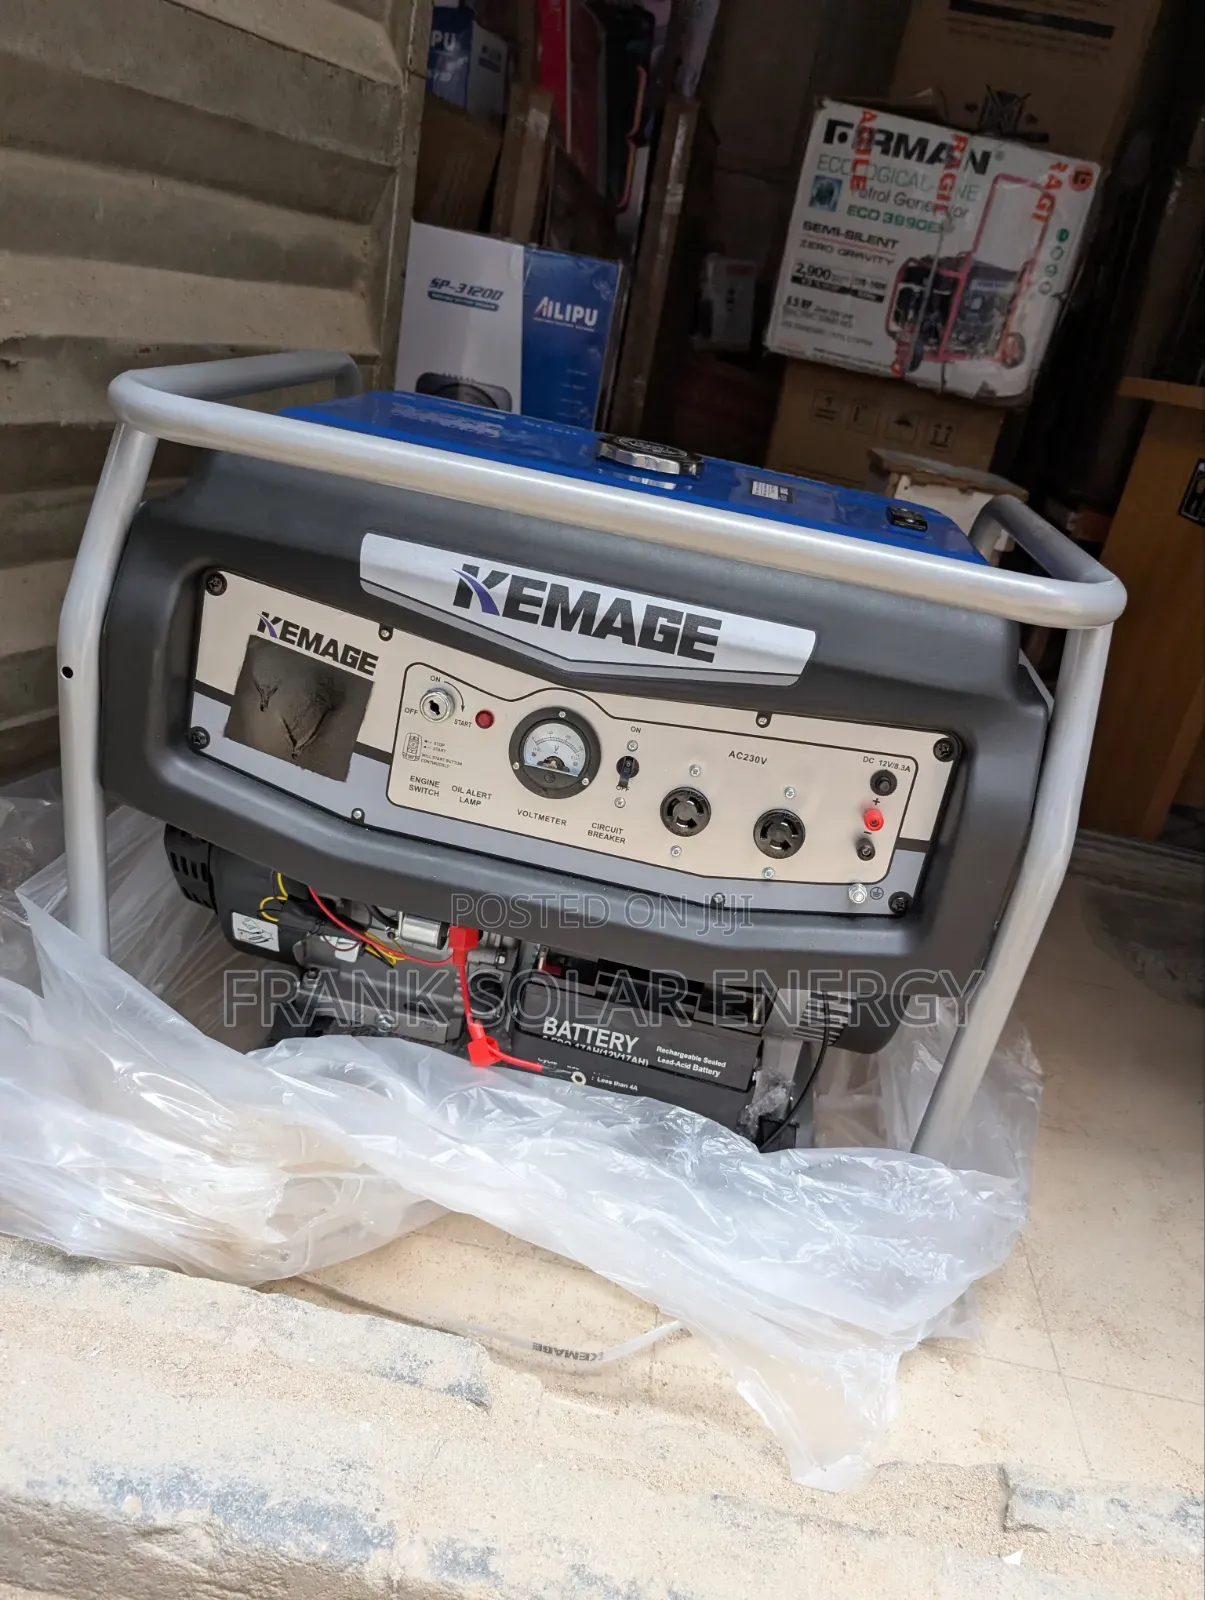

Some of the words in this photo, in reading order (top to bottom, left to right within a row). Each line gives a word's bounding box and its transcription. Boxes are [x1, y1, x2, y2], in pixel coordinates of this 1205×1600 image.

[847, 205, 880, 221] ECO
[802, 221, 899, 249] SEMI-SILENT
[800, 240, 834, 254] ZERO
[838, 248, 896, 266] GRAVITY
[534, 296, 598, 327] AILIPU
[452, 564, 722, 663] KEMAGE
[257, 611, 379, 677] KEMAGE
[429, 675, 441, 683] ON
[404, 707, 419, 716] OFF
[453, 718, 472, 728] START
[630, 726, 641, 734] ON
[728, 750, 768, 766] AC230V
[862, 755, 875, 764] DC
[878, 759, 911, 773] 12V/8.3A
[409, 775, 440, 788] ENGINE
[408, 784, 440, 798] SWITCH
[451, 785, 465, 794] OIL
[465, 787, 492, 800] ALERT
[459, 796, 482, 807] LAMP
[516, 809, 567, 827] VOLTMETER
[587, 829, 626, 845] BREAKER
[591, 822, 624, 836] CIRCUIT
[542, 1016, 640, 1054] BATTERY
[656, 1046, 701, 1061] Rechargeable
[702, 1055, 726, 1068] Sealed
[657, 1056, 691, 1070] Lead-Acid
[692, 1063, 722, 1078] Battery
[596, 1076, 613, 1085] Less
[614, 1079, 628, 1089] than
